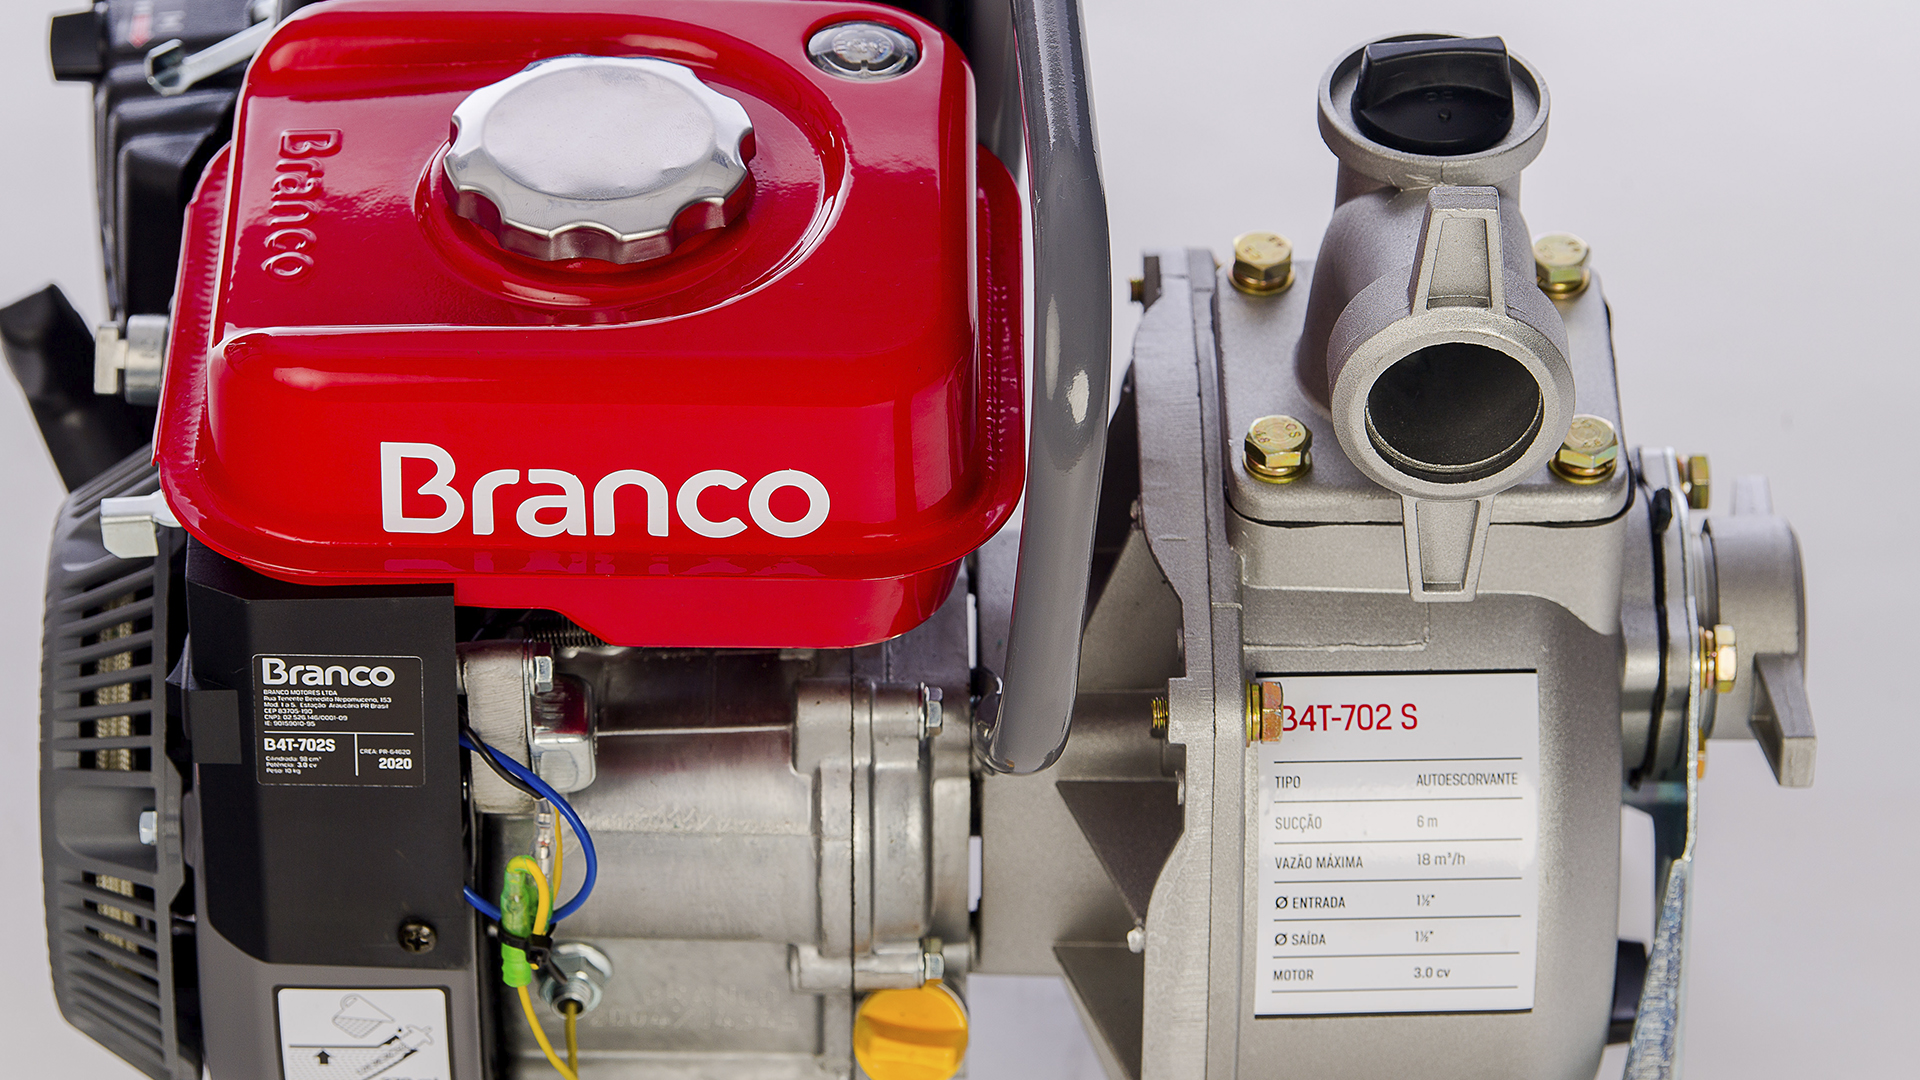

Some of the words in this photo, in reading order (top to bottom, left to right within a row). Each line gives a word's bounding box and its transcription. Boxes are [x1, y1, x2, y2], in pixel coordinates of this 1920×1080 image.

[261, 128, 343, 279] Branco
[380, 441, 831, 538] Branco
[262, 658, 396, 687] Branco
[1401, 703, 1418, 730] S
[263, 737, 336, 752] B4T-702S
[378, 757, 413, 770] 2020
[1275, 775, 1301, 789] TIPO
[1416, 772, 1518, 787] AUTOESCORVANTE
[1275, 813, 1322, 833] SUCÇÃO
[1416, 815, 1424, 828] 6
[1427, 817, 1438, 828] m
[1275, 855, 1312, 870] VAZÃO
[1316, 853, 1363, 869] MÁXIMA
[1416, 853, 1430, 866] 18
[1292, 896, 1346, 909] ENTRADA
[1291, 930, 1326, 946] SAÍDA
[1273, 969, 1314, 981] MOTOR
[1413, 967, 1433, 979] 3.0
[1436, 968, 1451, 979] cv
